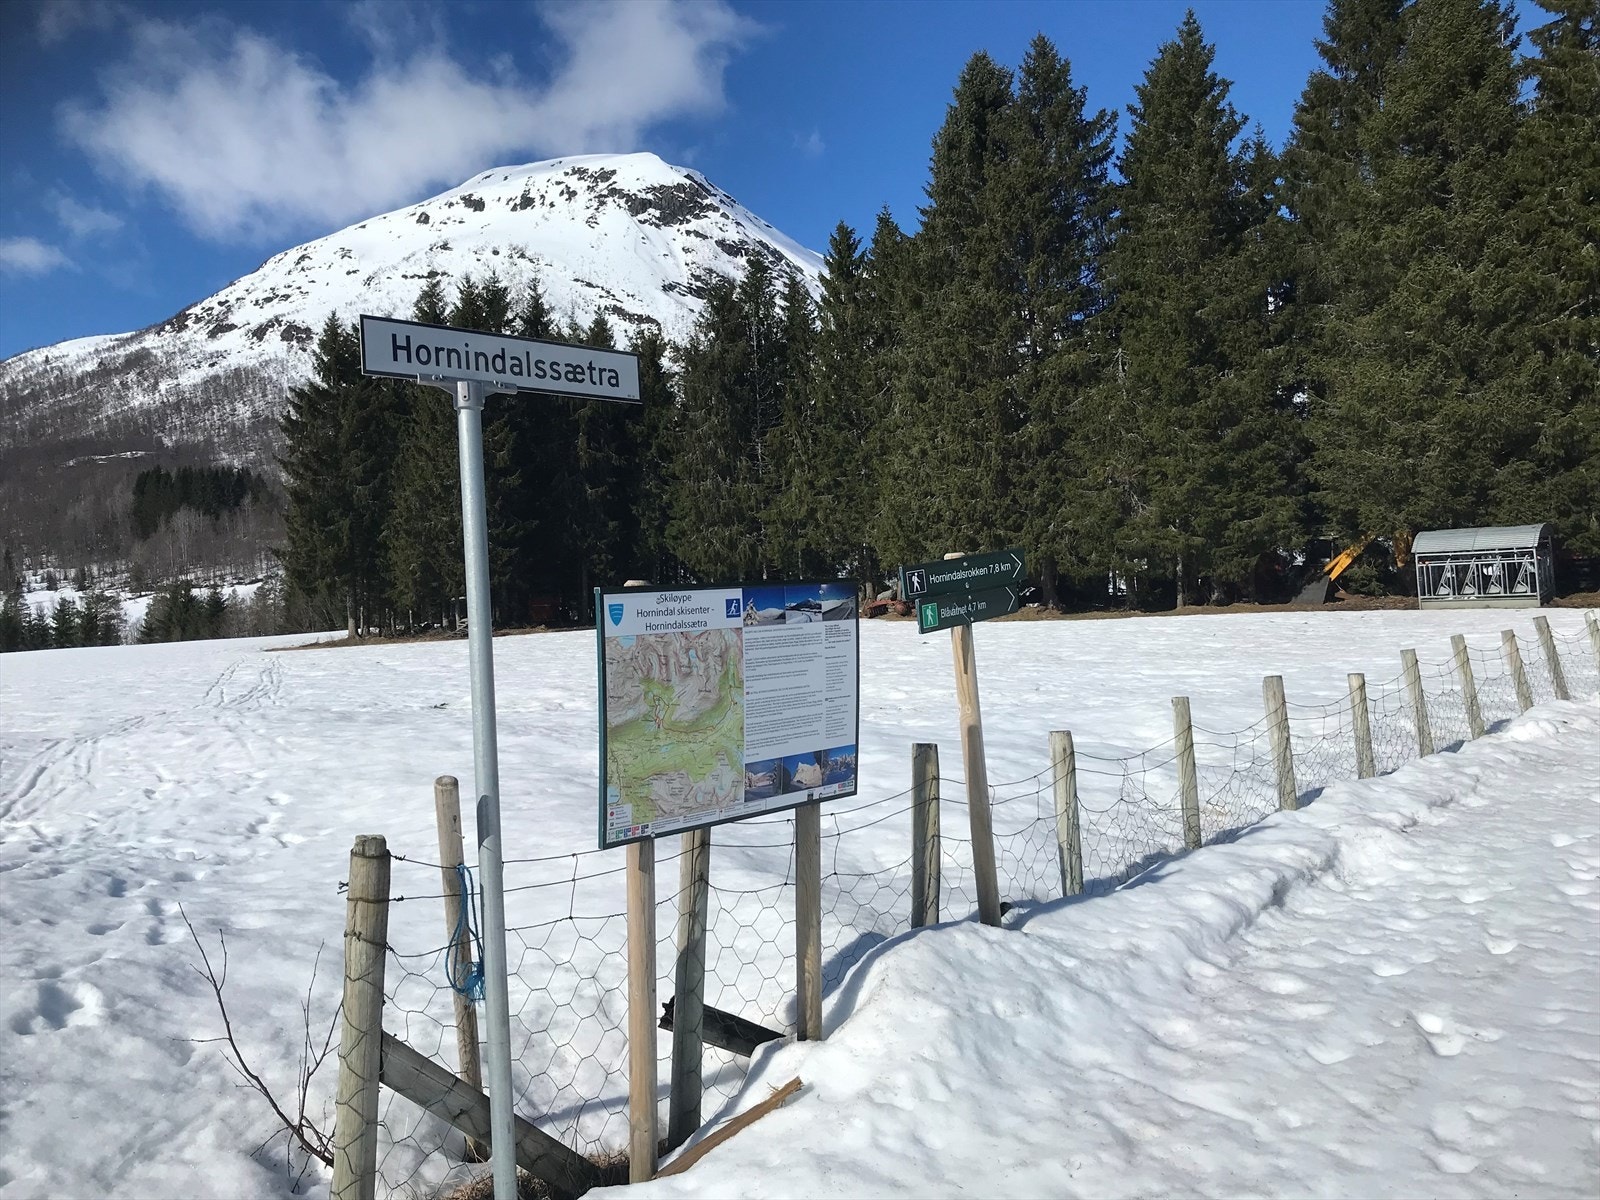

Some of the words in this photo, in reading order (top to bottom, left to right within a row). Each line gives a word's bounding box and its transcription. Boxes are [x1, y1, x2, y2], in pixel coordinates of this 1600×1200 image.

[391, 333, 620, 388] Hornindalssætra
[929, 566, 988, 584] Hornindalsrokken
[988, 563, 1000, 575] 7,8
[1000, 562, 1011, 572] km
[659, 593, 692, 604] Skiløype
[636, 607, 676, 618] Hornindal
[677, 606, 710, 616] skisenter
[968, 602, 977, 613] 4,7
[977, 601, 987, 611] km
[645, 620, 708, 631] Hornindalssætra
